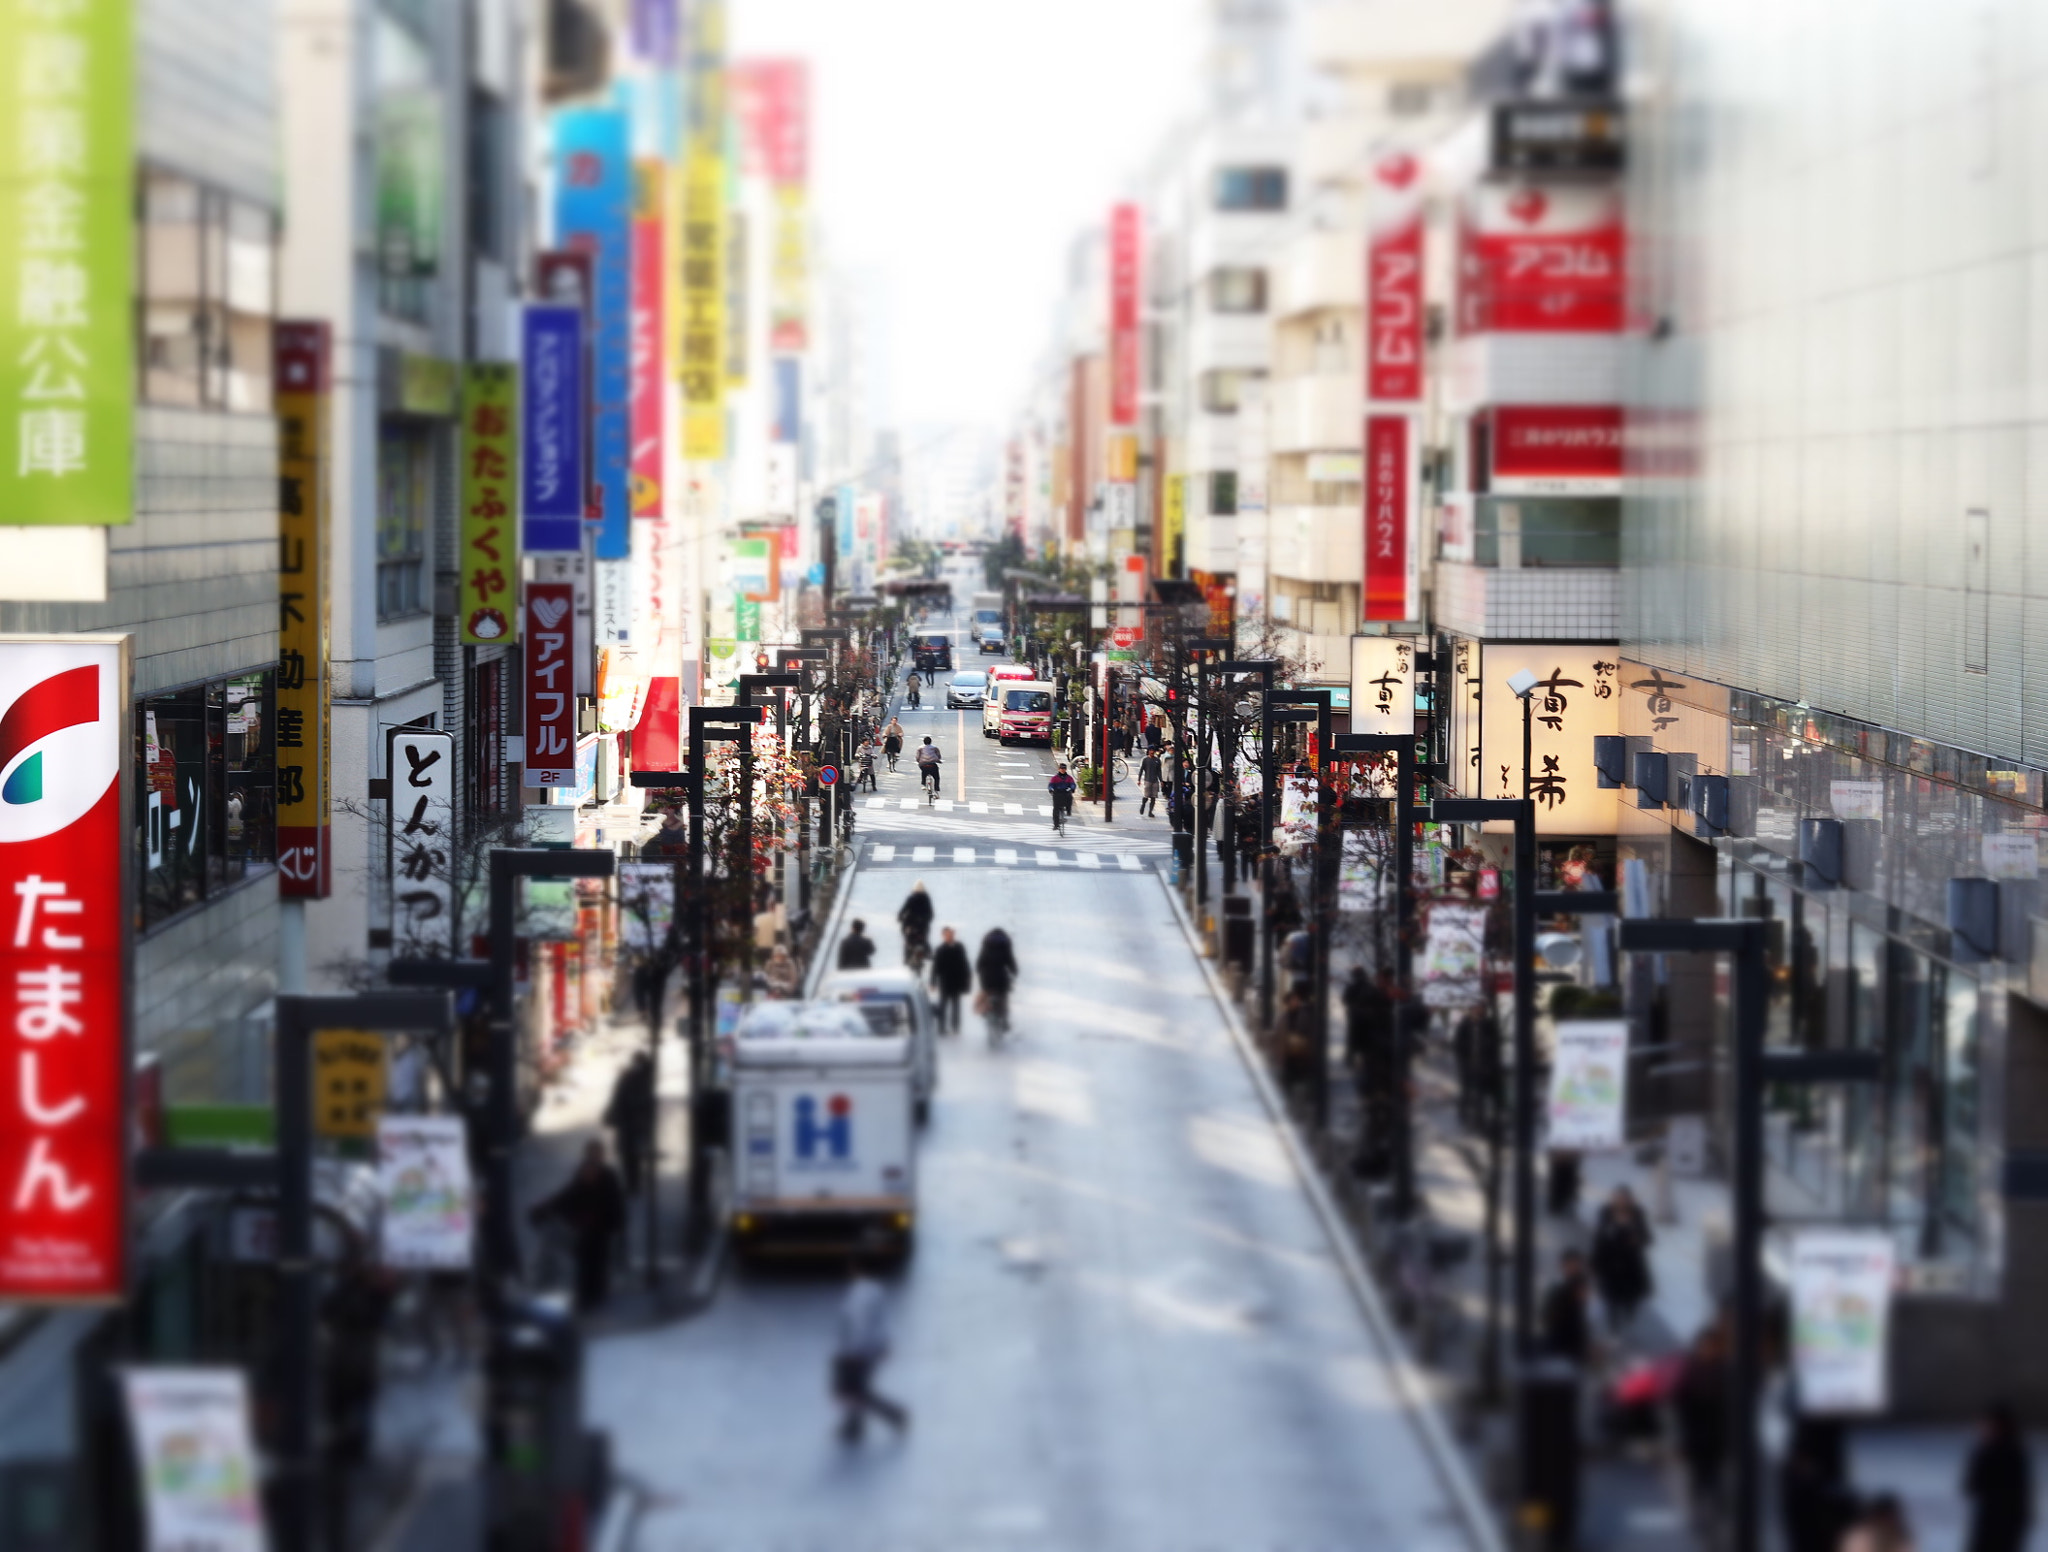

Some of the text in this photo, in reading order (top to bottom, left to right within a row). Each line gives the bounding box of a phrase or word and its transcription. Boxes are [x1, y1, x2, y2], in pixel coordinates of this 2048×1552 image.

[19, 0, 88, 478] 金融公庫
[1506, 243, 1610, 278] アコム
[1377, 252, 1414, 365] アコム
[470, 404, 507, 602] おたふくや
[1377, 431, 1394, 558] 三井のリハウス
[535, 633, 568, 755] アイフル
[1369, 670, 1403, 735] 真
[1593, 660, 1618, 699] 地酒
[148, 776, 201, 871] ローン
[401, 745, 446, 921] とんかつ
[540, 771, 560, 783] 2F
[278, 846, 316, 881] くじ
[14, 874, 91, 1211] たましん
